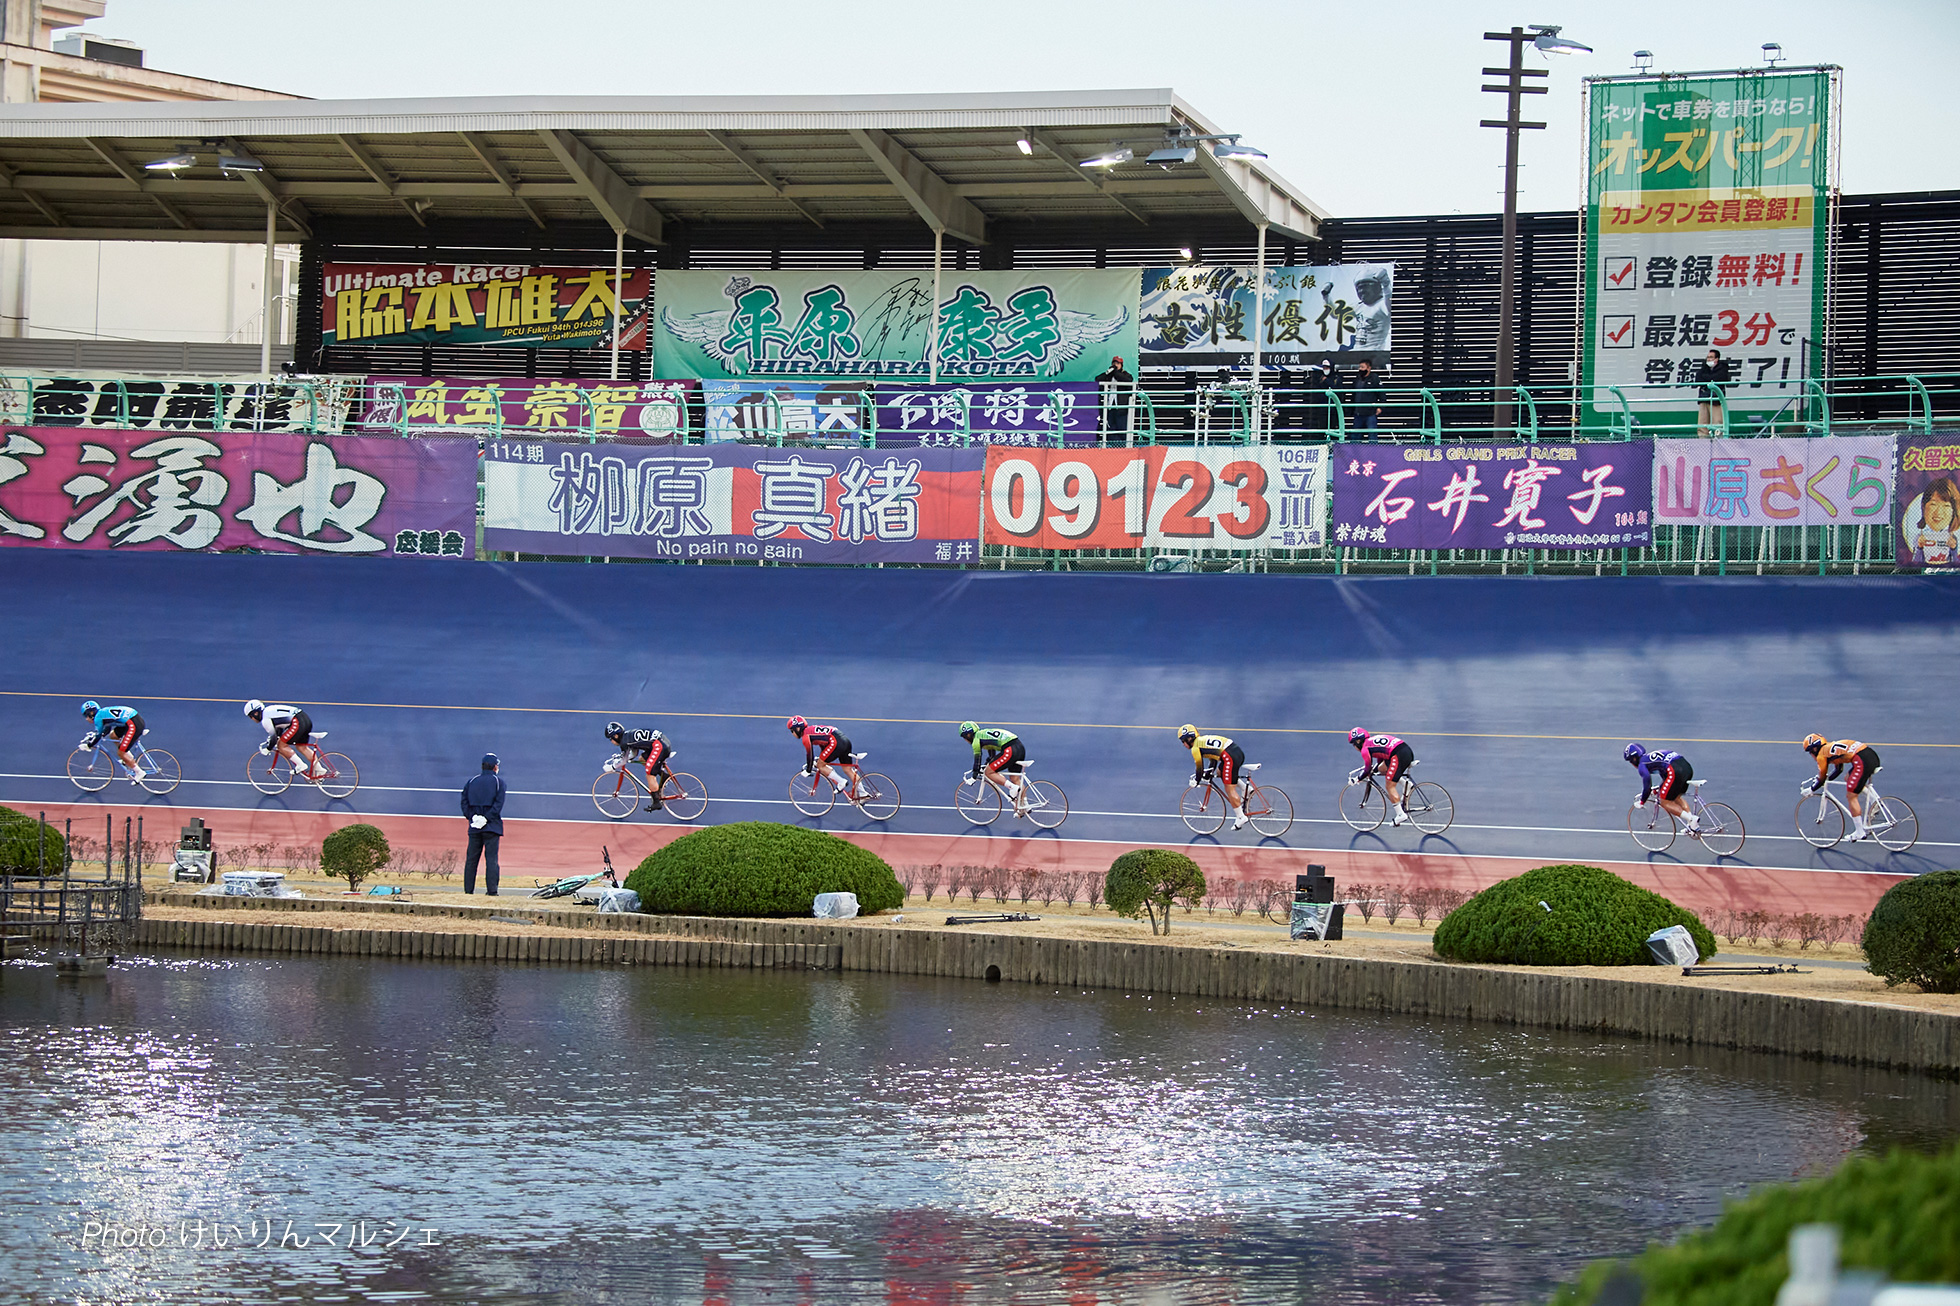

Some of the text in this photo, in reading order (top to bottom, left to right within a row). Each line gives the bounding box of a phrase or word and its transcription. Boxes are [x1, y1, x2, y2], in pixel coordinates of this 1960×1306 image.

[1602, 95, 1815, 122] ネットで車券を買うなら!
[1594, 123, 1820, 175] オッズパーク!
[1611, 197, 1800, 226] カンタン会員登録!
[325, 264, 531, 297] Ultimate Racer
[1643, 253, 1804, 289] 登録無料!
[336, 270, 632, 341] 脇本雄太
[502, 319, 604, 337] JPCU Fukui 94th 014396
[543, 329, 601, 341] Yuta Wakimoto
[719, 284, 861, 362] 平原
[928, 284, 1063, 362] 康多
[1155, 299, 1356, 346] 古性優作
[1643, 309, 1796, 348] 最短3分で
[746, 358, 1037, 377] HIRAHARA KOTA
[399, 380, 640, 432] 瓜生崇智
[491, 442, 544, 462] 114期
[1278, 449, 1319, 463] 106期
[1403, 446, 1577, 461] GIRLS GRAND PRIX RACER
[1903, 445, 1960, 472] 久留米
[1344, 459, 1377, 477] 東京
[752, 454, 921, 544] 真緒
[1279, 466, 1316, 529] 立川
[1364, 459, 1625, 535] 石井寛子
[1659, 455, 1887, 519] 山原さくら
[393, 529, 466, 557] 応援会
[657, 539, 803, 561] No pain no gain
[934, 542, 973, 561] 福井
[634, 730, 650, 741] 2
[815, 726, 831, 735] 3
[986, 730, 1001, 740] 6
[1206, 738, 1222, 749] 5
[1373, 737, 1389, 746] 8
[1830, 742, 1848, 754] 7
